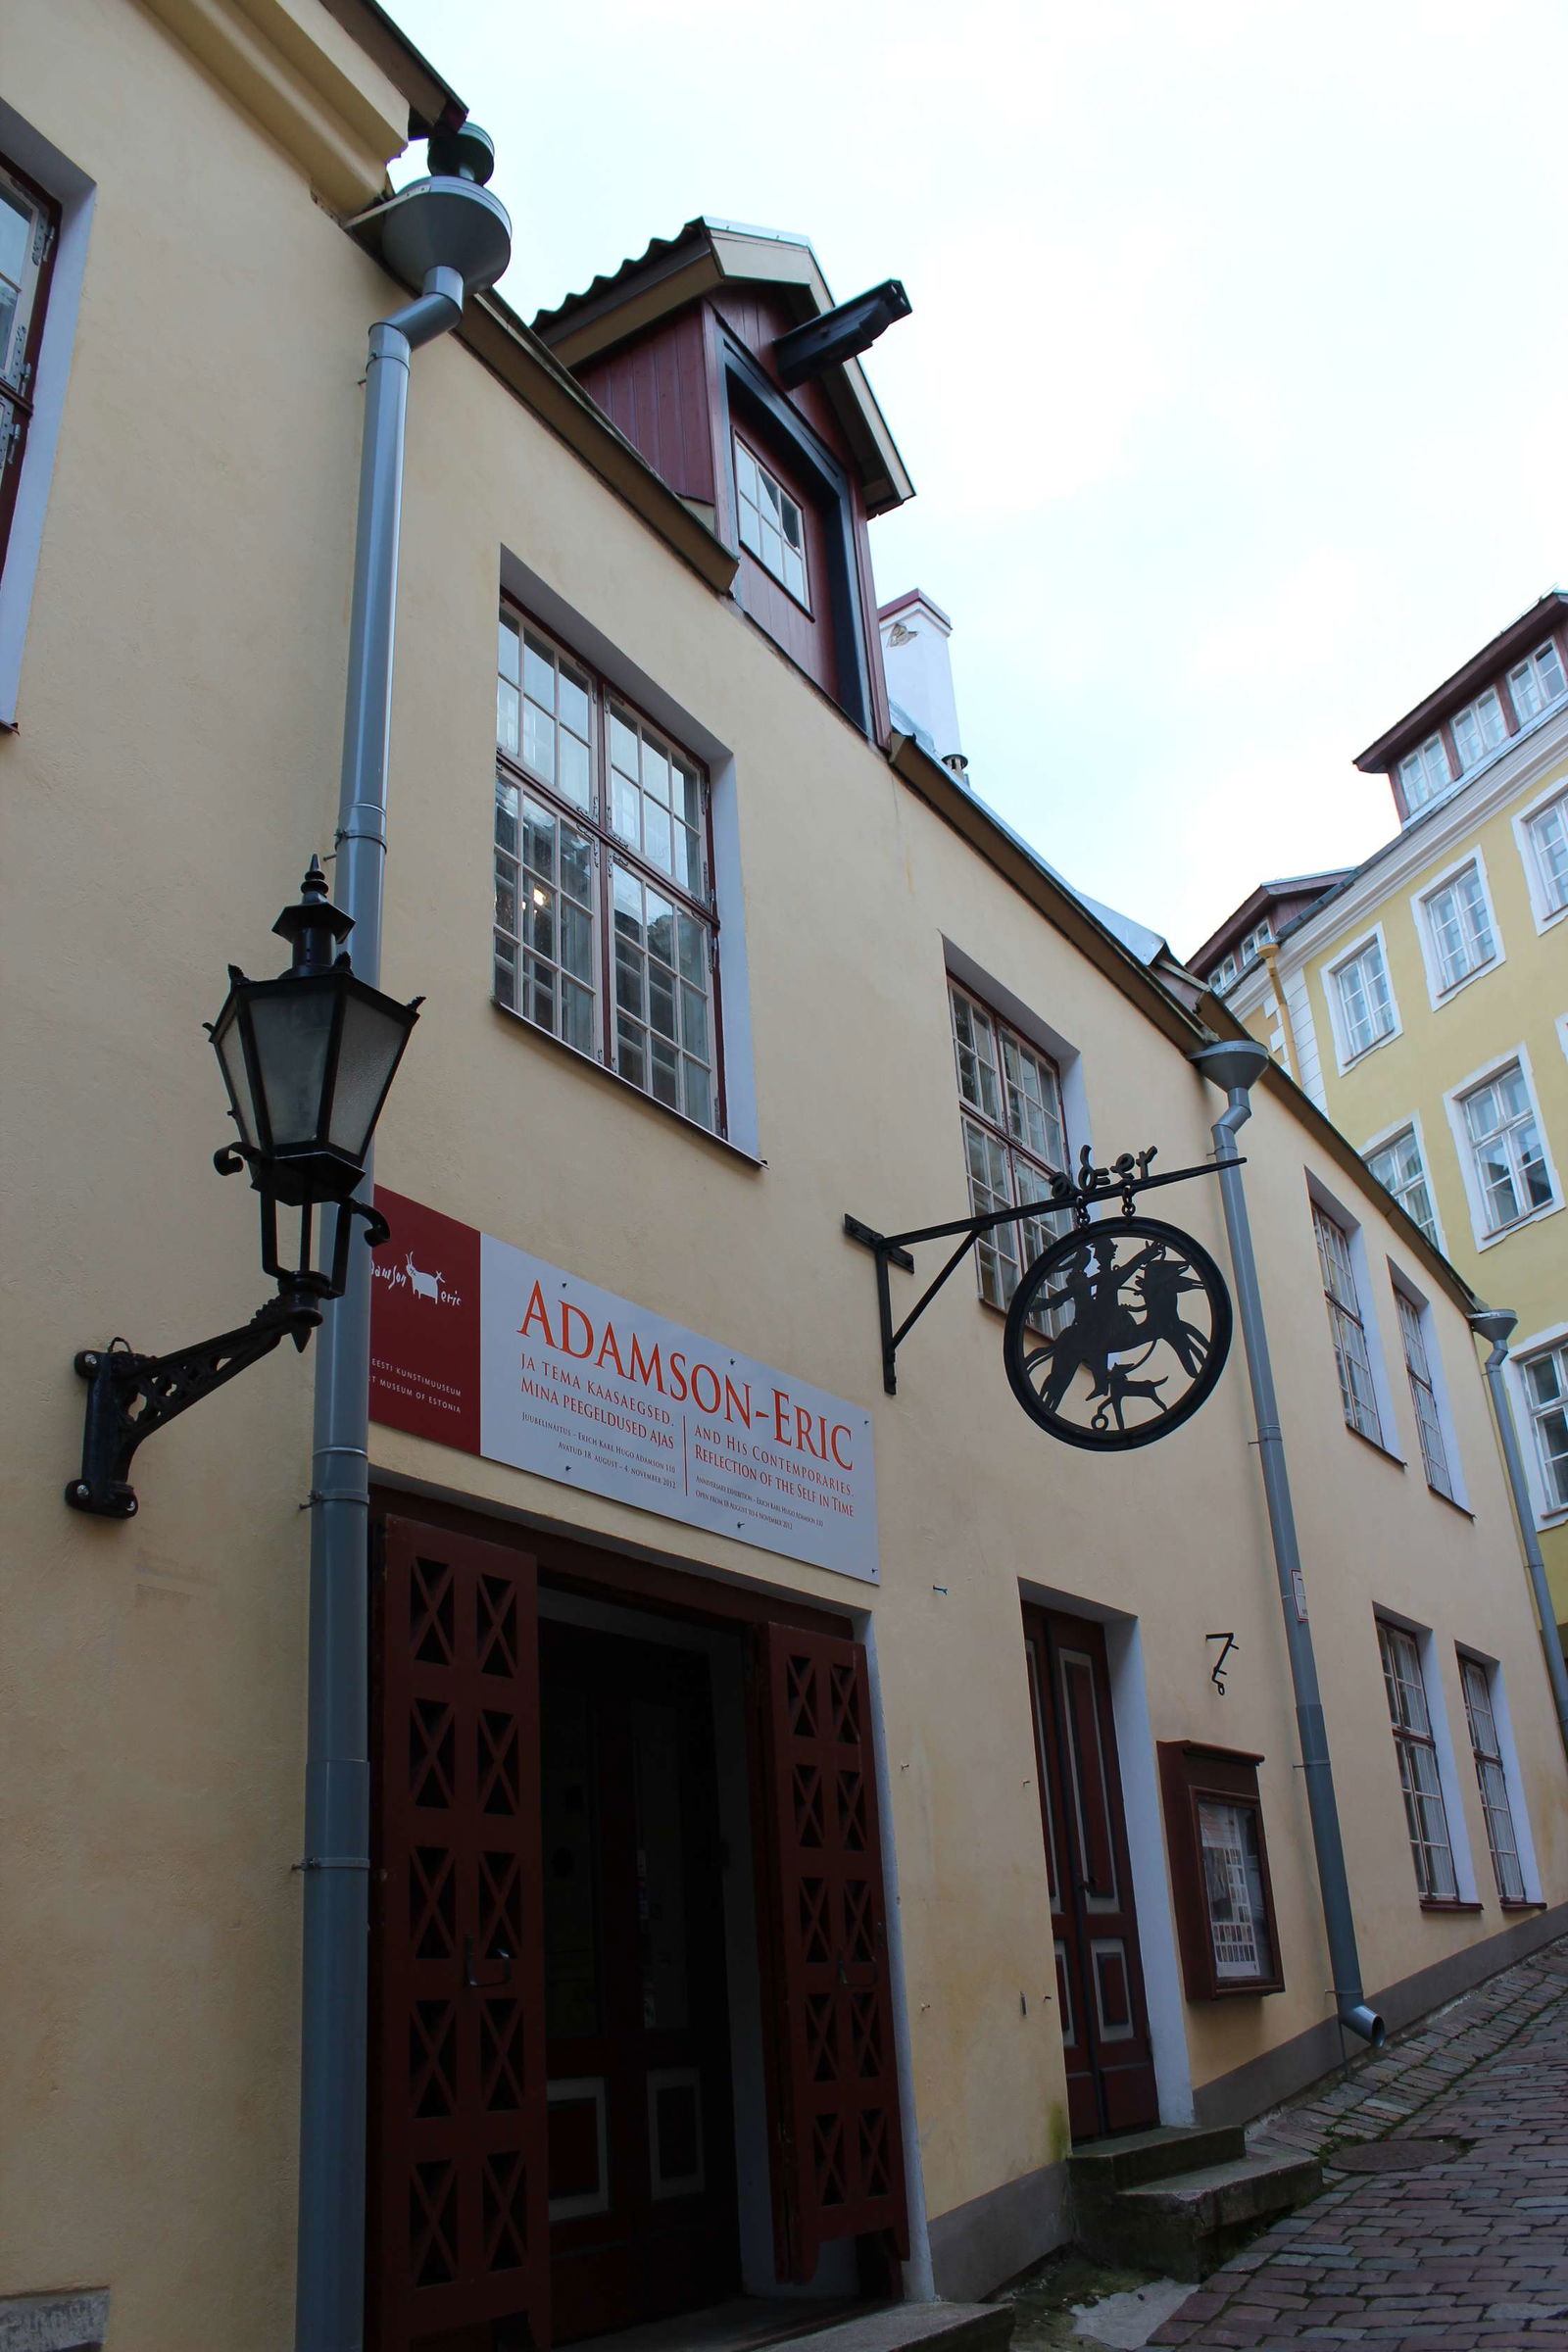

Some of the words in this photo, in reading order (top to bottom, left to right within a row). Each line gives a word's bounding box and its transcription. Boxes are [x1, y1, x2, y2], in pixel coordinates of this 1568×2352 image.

[371, 1358, 393, 1372] EESTI
[396, 1367, 462, 1396] KUNSTIMUUSEUM
[516, 1279, 855, 1471] ADAMSON-ERIC
[520, 1352, 536, 1372] JA
[542, 1360, 581, 1390] TEMA
[587, 1379, 674, 1427] KAASAEGSED.
[379, 1379, 413, 1396] MUSEUM
[416, 1392, 426, 1400] OF
[428, 1396, 462, 1414] ESTONIA
[520, 1377, 559, 1405] MINA
[563, 1395, 647, 1439] PEEGELDUSED
[650, 1430, 674, 1449] AJAS
[695, 1424, 721, 1446] AND
[760, 1471, 773, 1487] OF
[775, 1476, 795, 1496] THE
[819, 1494, 830, 1508] IN
